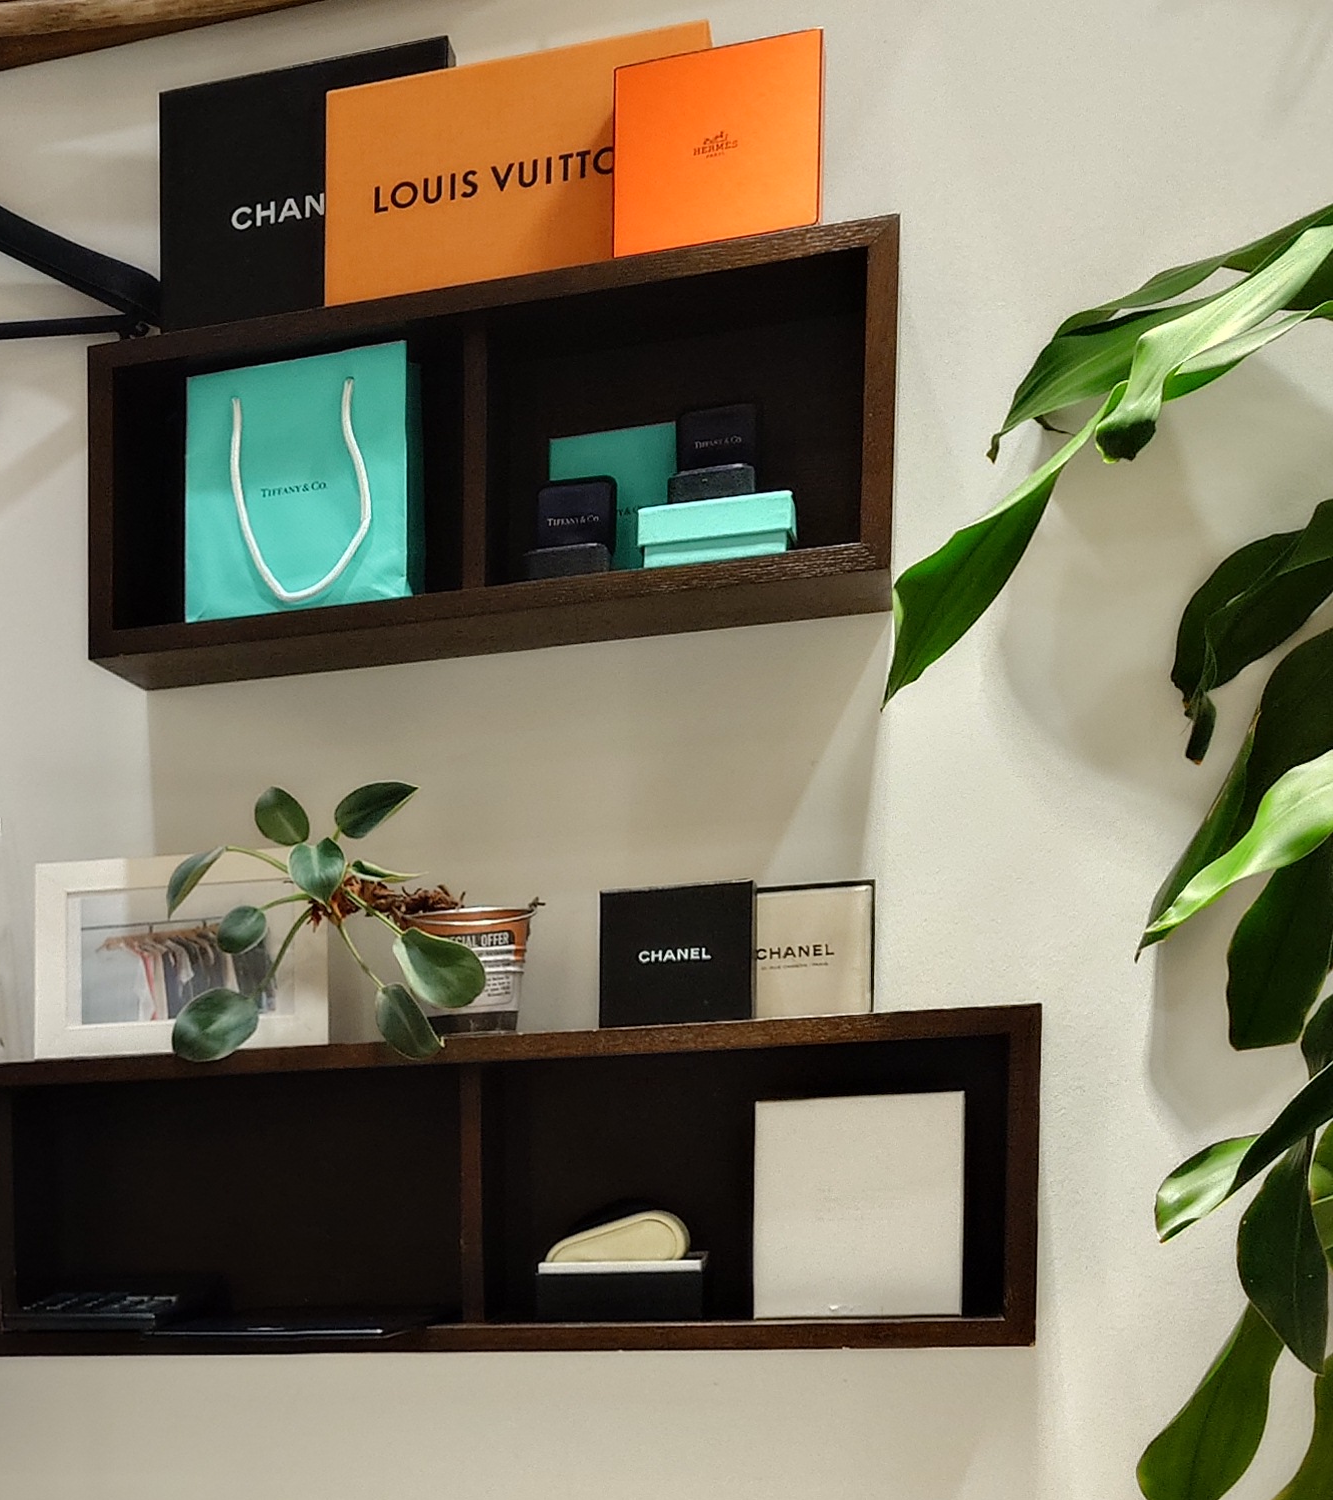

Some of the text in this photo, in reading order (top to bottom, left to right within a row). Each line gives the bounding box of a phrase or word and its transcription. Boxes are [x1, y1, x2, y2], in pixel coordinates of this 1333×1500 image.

[374, 146, 614, 213] LOUIS VUITTO
[231, 192, 326, 230] CHAN
[451, 932, 510, 948] CIAL OFFER
[638, 947, 712, 963] CHANEL
[755, 943, 835, 961] CHANEL
